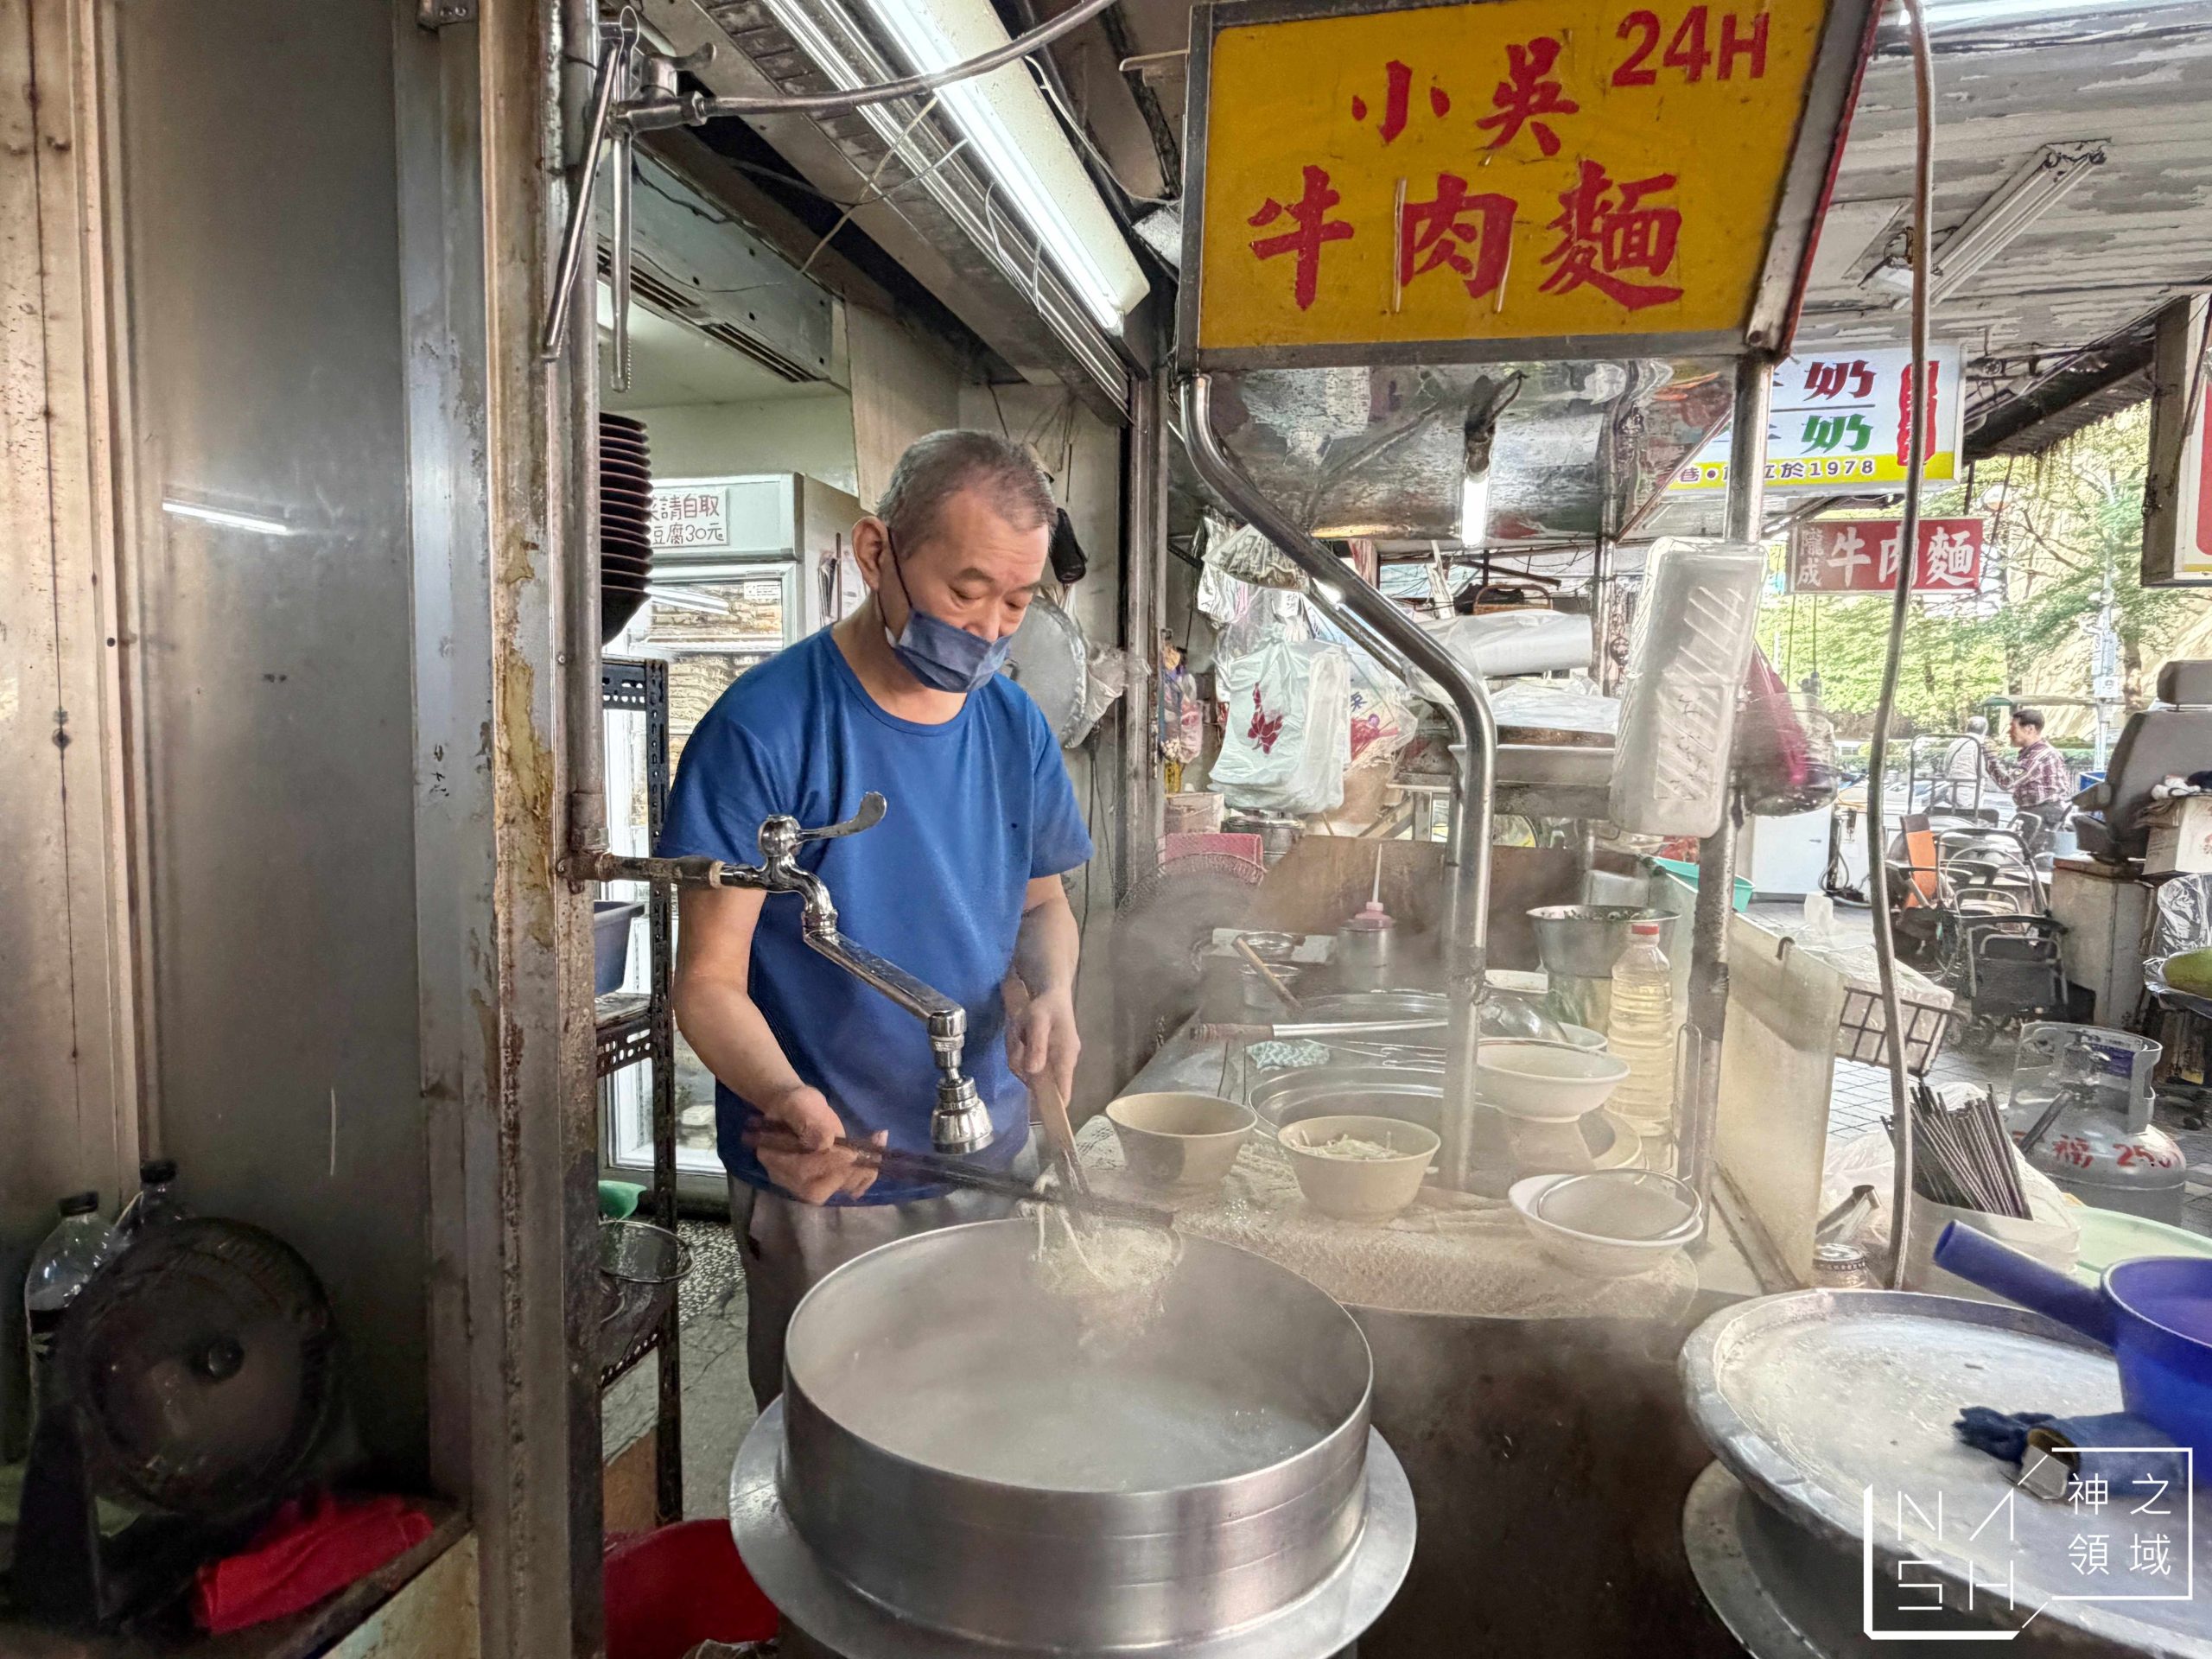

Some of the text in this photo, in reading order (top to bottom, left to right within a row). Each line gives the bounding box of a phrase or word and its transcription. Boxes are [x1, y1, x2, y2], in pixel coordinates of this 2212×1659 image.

[1611, 5, 1770, 86] 24H
[1352, 36, 1580, 156] 小吳
[1249, 159, 1684, 311] 牛肉麵
[1773, 359, 1877, 401] 奶
[1769, 414, 1873, 454] 奶
[1826, 525, 1975, 588] 牛肉麵
